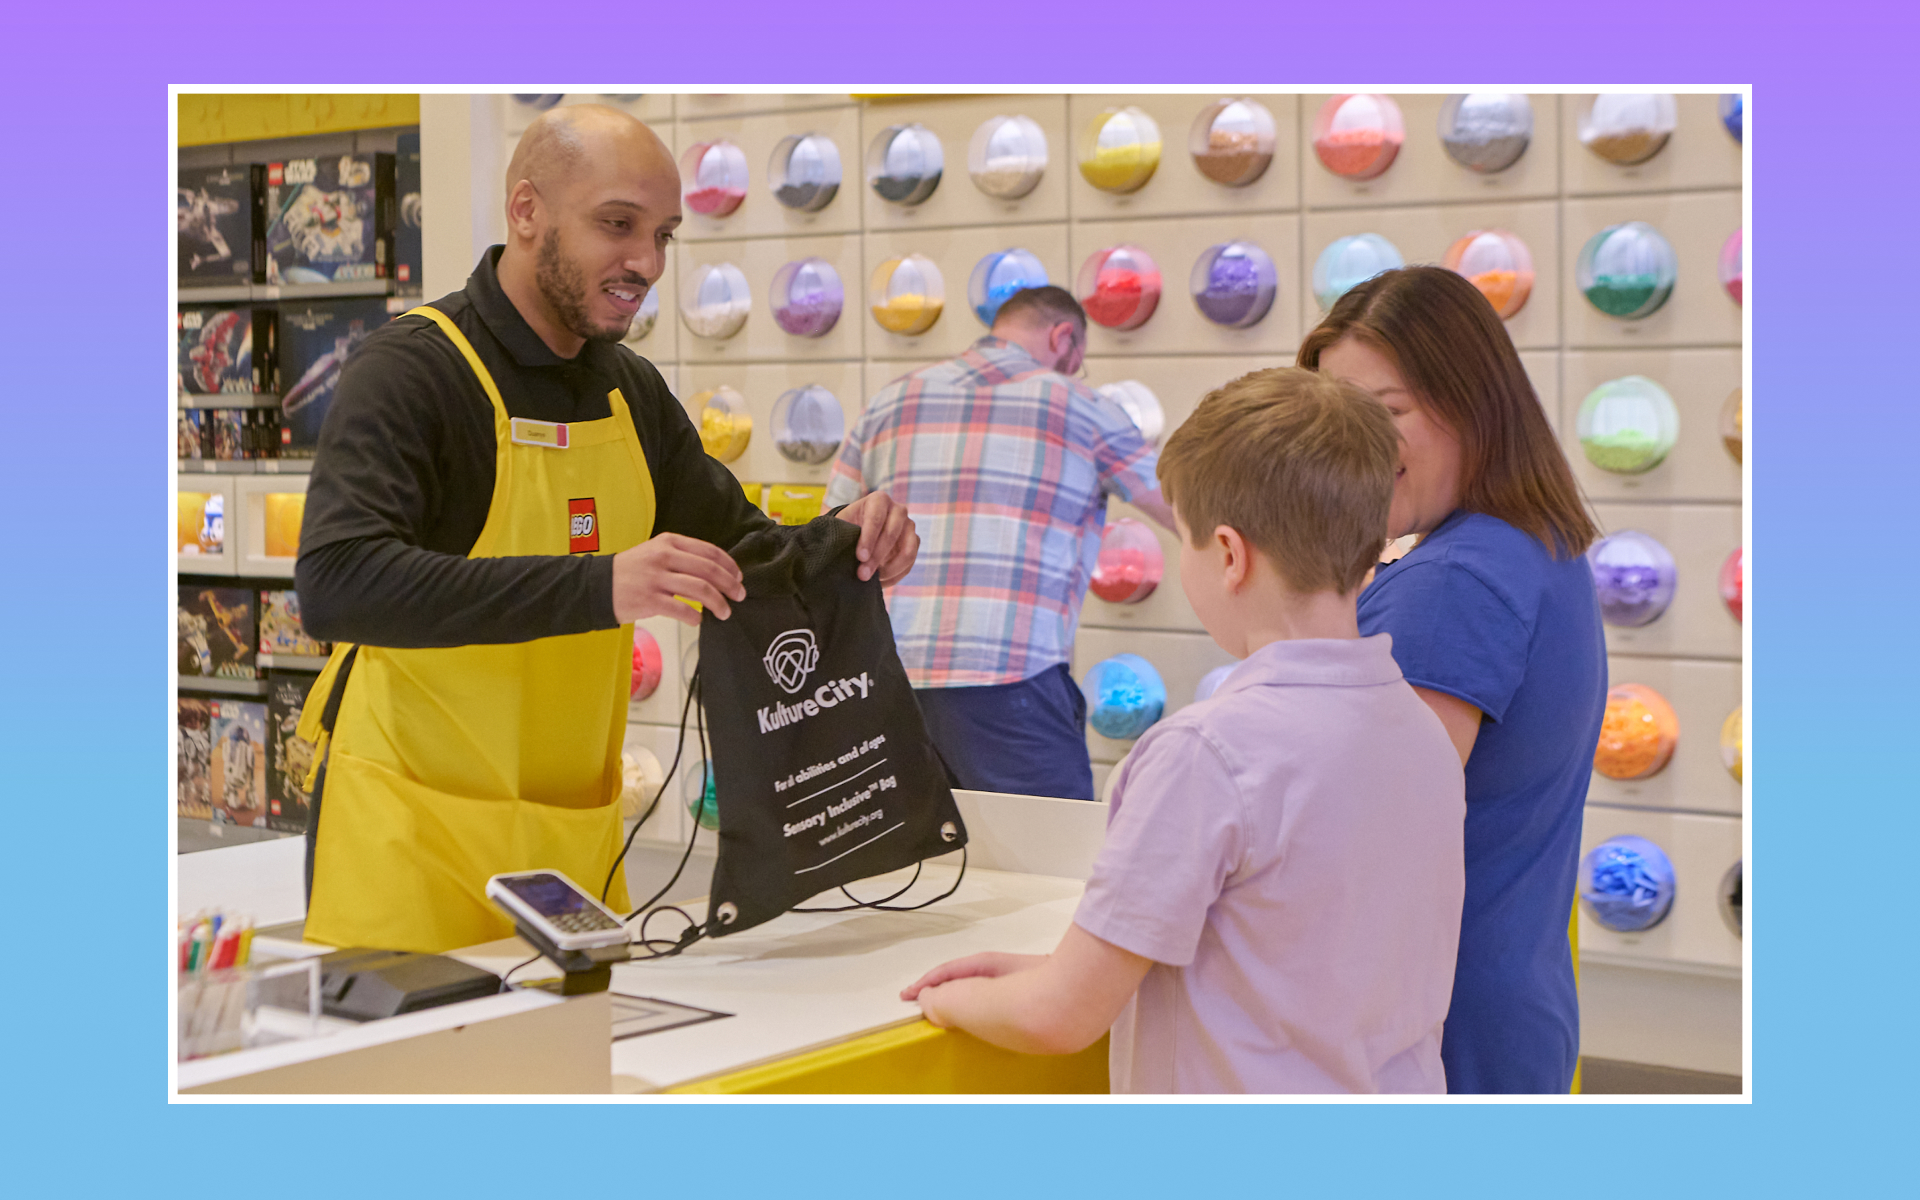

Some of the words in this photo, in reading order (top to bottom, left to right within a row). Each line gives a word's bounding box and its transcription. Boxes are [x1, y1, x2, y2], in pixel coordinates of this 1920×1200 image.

[570, 513, 594, 537] LEGO
[774, 780, 787, 792] For
[795, 760, 837, 783] abilities
[838, 746, 859, 764] and
[869, 734, 885, 749] ages
[783, 811, 825, 837] Sensory
[879, 775, 897, 791] Bag
